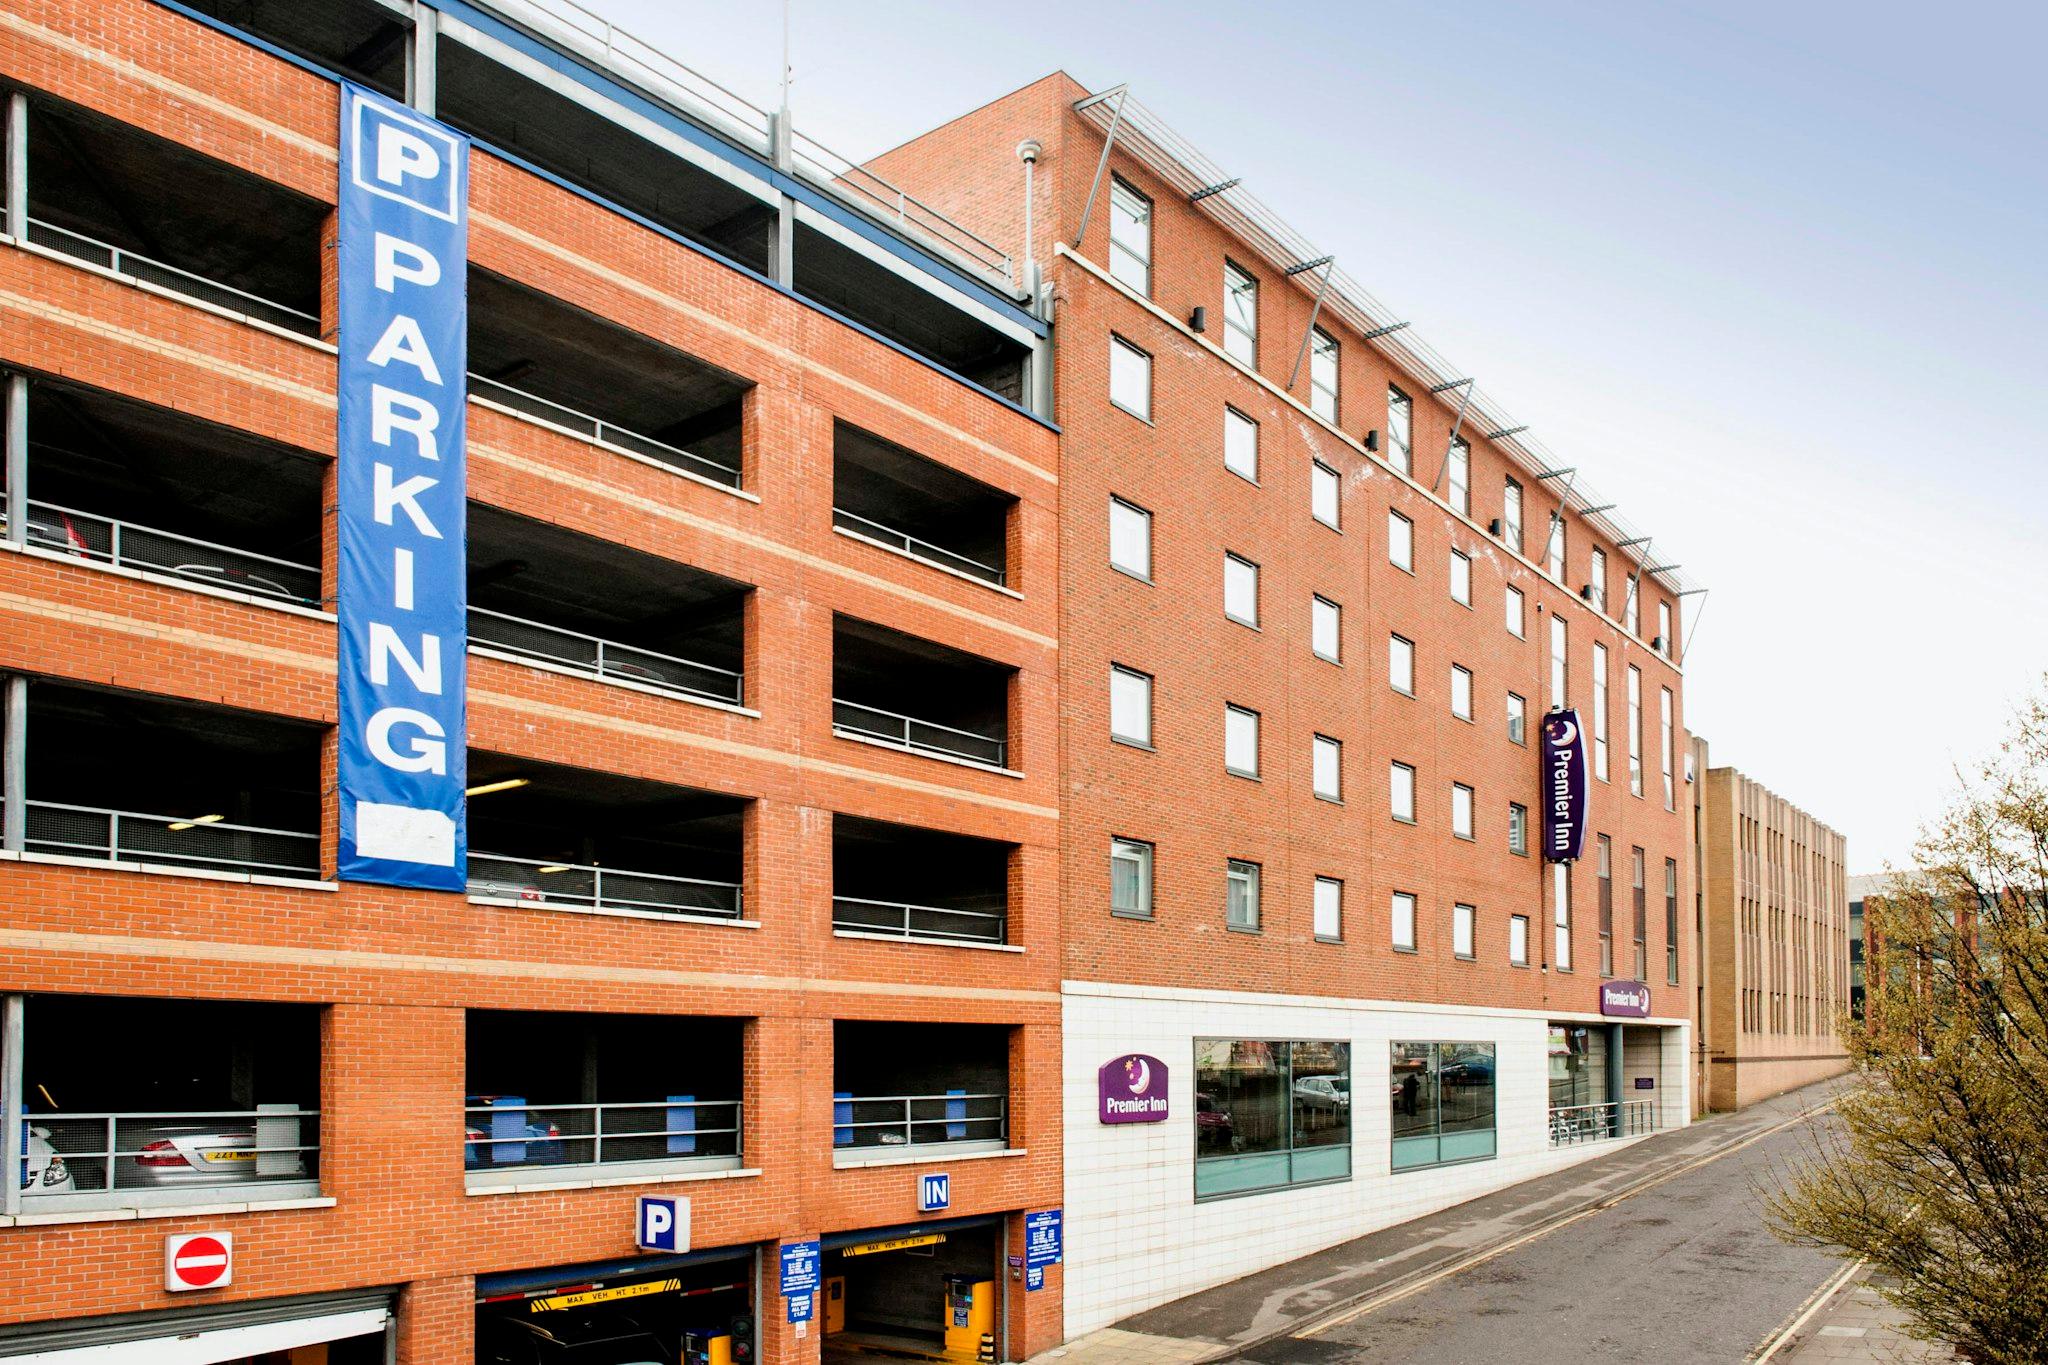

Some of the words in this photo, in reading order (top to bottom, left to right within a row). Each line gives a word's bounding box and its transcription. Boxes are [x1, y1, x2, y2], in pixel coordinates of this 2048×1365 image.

[377, 122, 440, 187] P
[365, 231, 447, 776] PARKING
[1554, 749, 1573, 820] Premier
[1555, 823, 1574, 851] Inn
[1605, 988, 1629, 1007] Premier
[1629, 990, 1640, 1007] Inn
[1106, 1096, 1149, 1114] Premier
[1150, 1096, 1167, 1112] Inn
[926, 1179, 947, 1204] IN
[646, 1203, 672, 1244] P
[567, 1295, 584, 1303] MAX
[592, 1292, 608, 1300] VEH
[616, 1289, 626, 1297] HT
[632, 1286, 649, 1294] 2.1m
